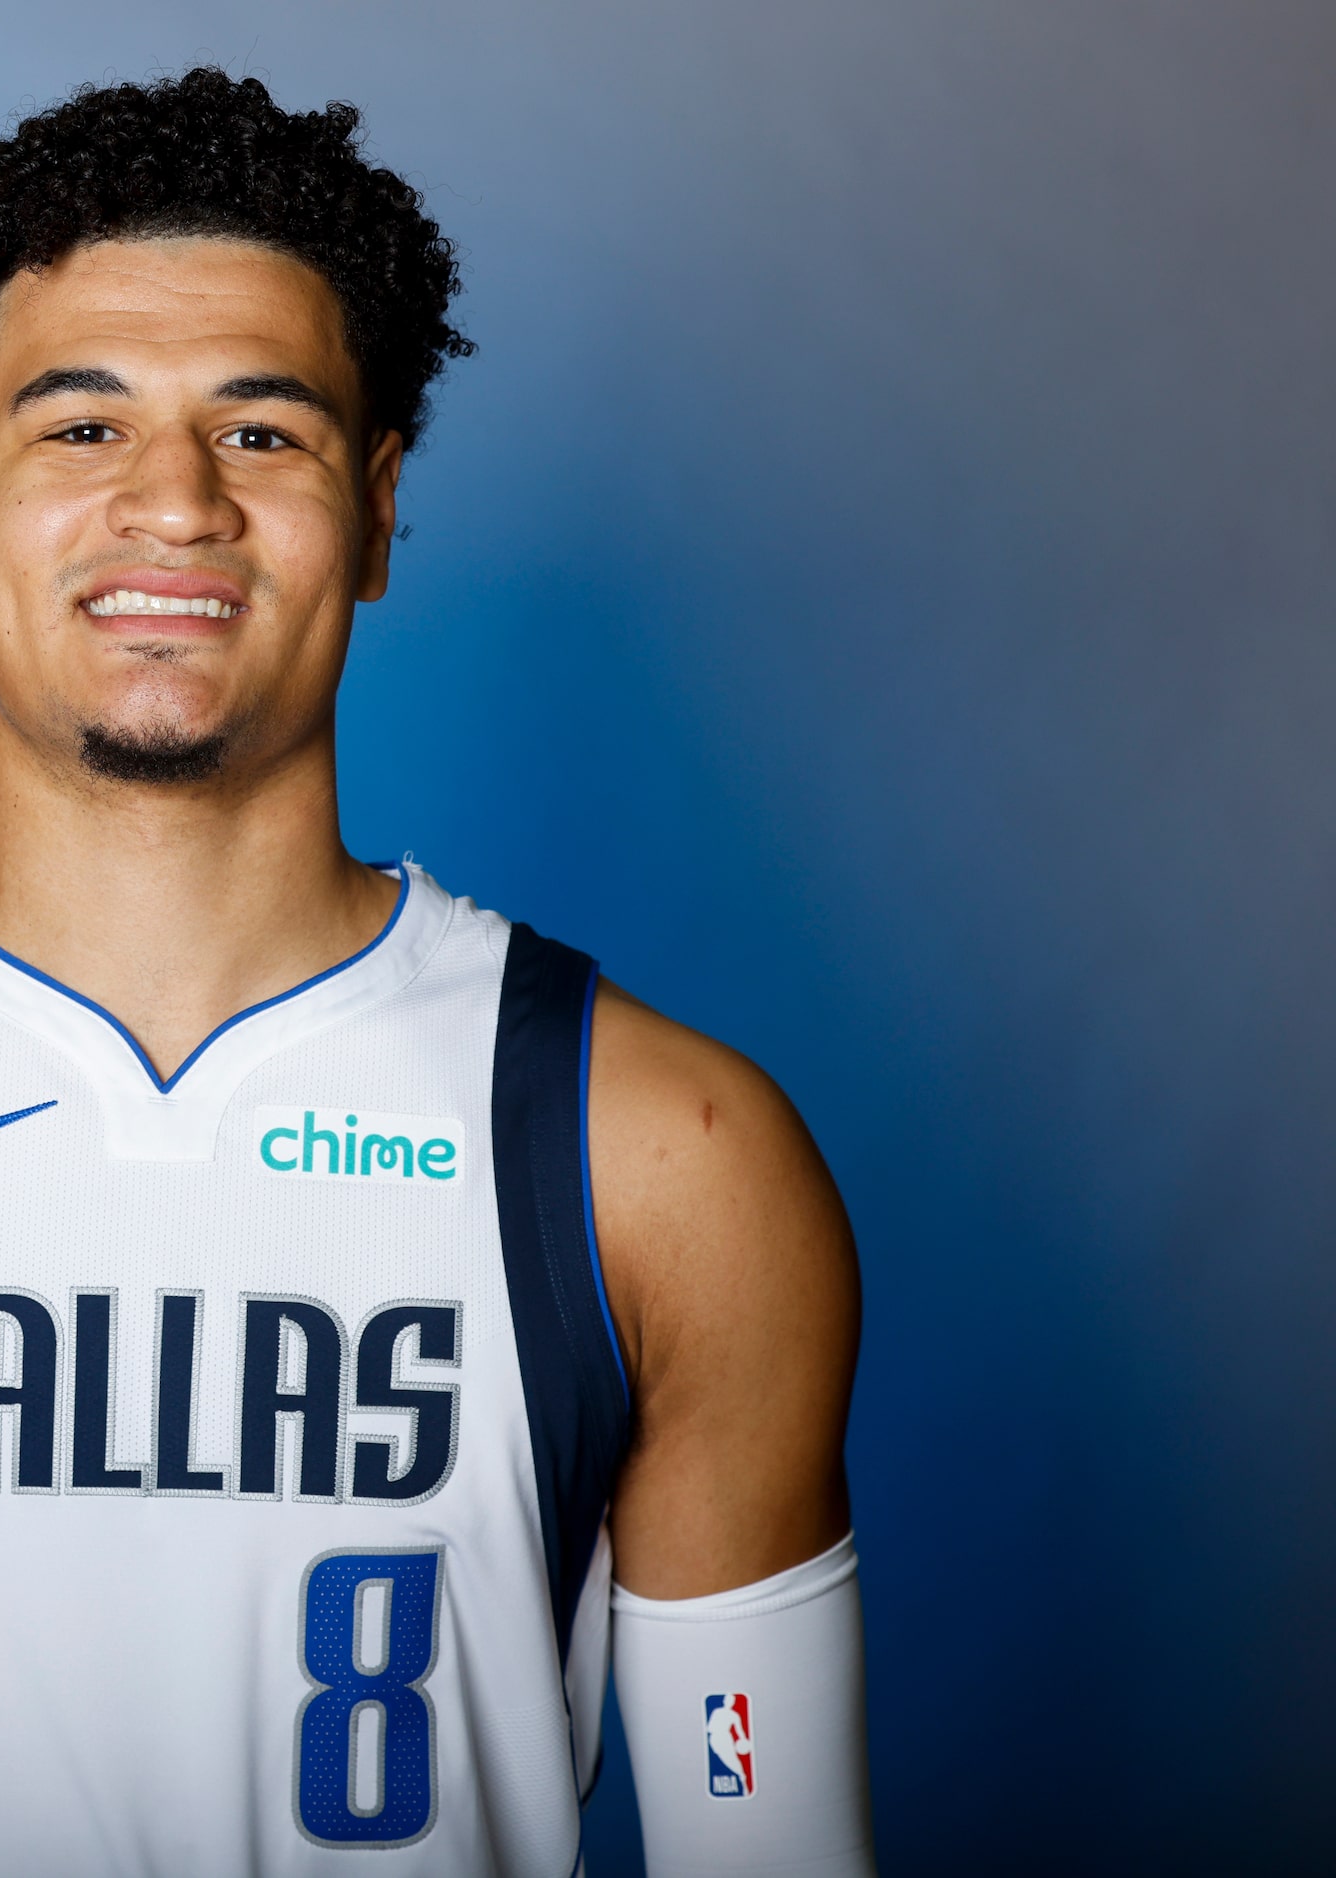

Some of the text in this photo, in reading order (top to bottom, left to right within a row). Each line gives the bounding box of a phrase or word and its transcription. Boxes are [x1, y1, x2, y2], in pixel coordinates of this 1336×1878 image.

[259, 1110, 457, 1180] chime
[291, 1544, 446, 1850] 8
[713, 1775, 739, 1793] NBA
